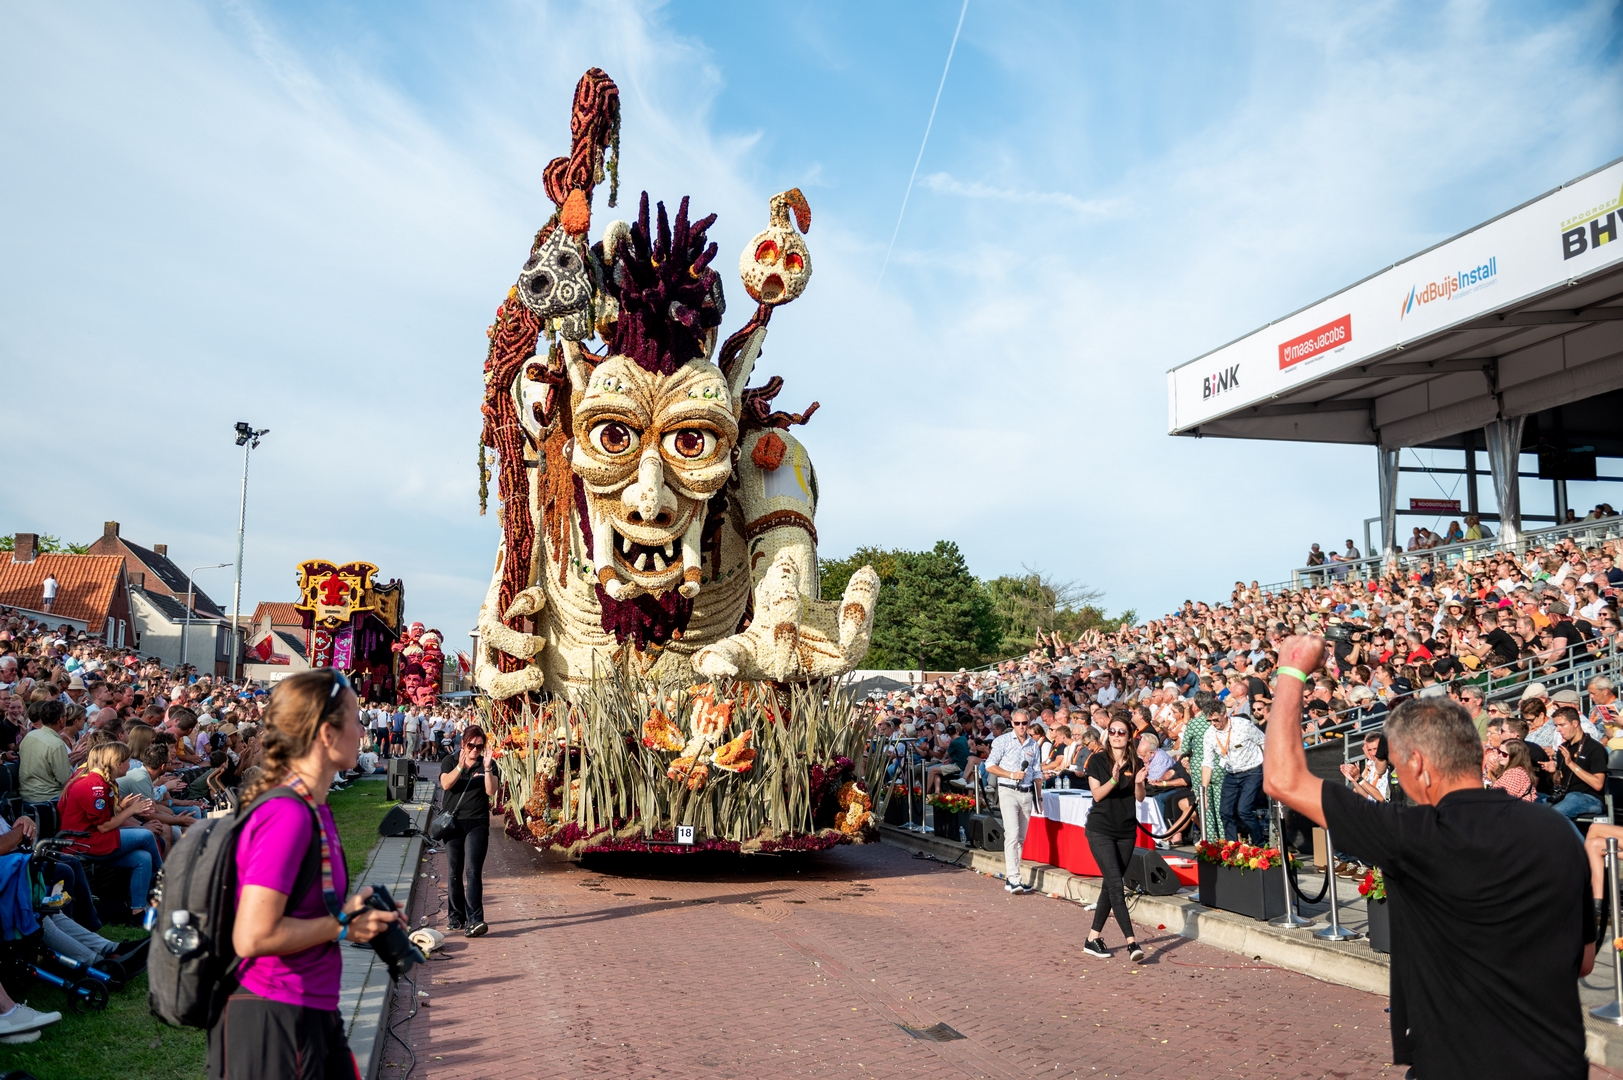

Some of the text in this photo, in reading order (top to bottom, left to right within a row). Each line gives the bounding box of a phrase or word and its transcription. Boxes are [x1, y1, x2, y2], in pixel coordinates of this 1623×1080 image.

[1560, 198, 1618, 228] EXPOGROEP
[1562, 207, 1623, 261] BH
[679, 828, 692, 838] 18
